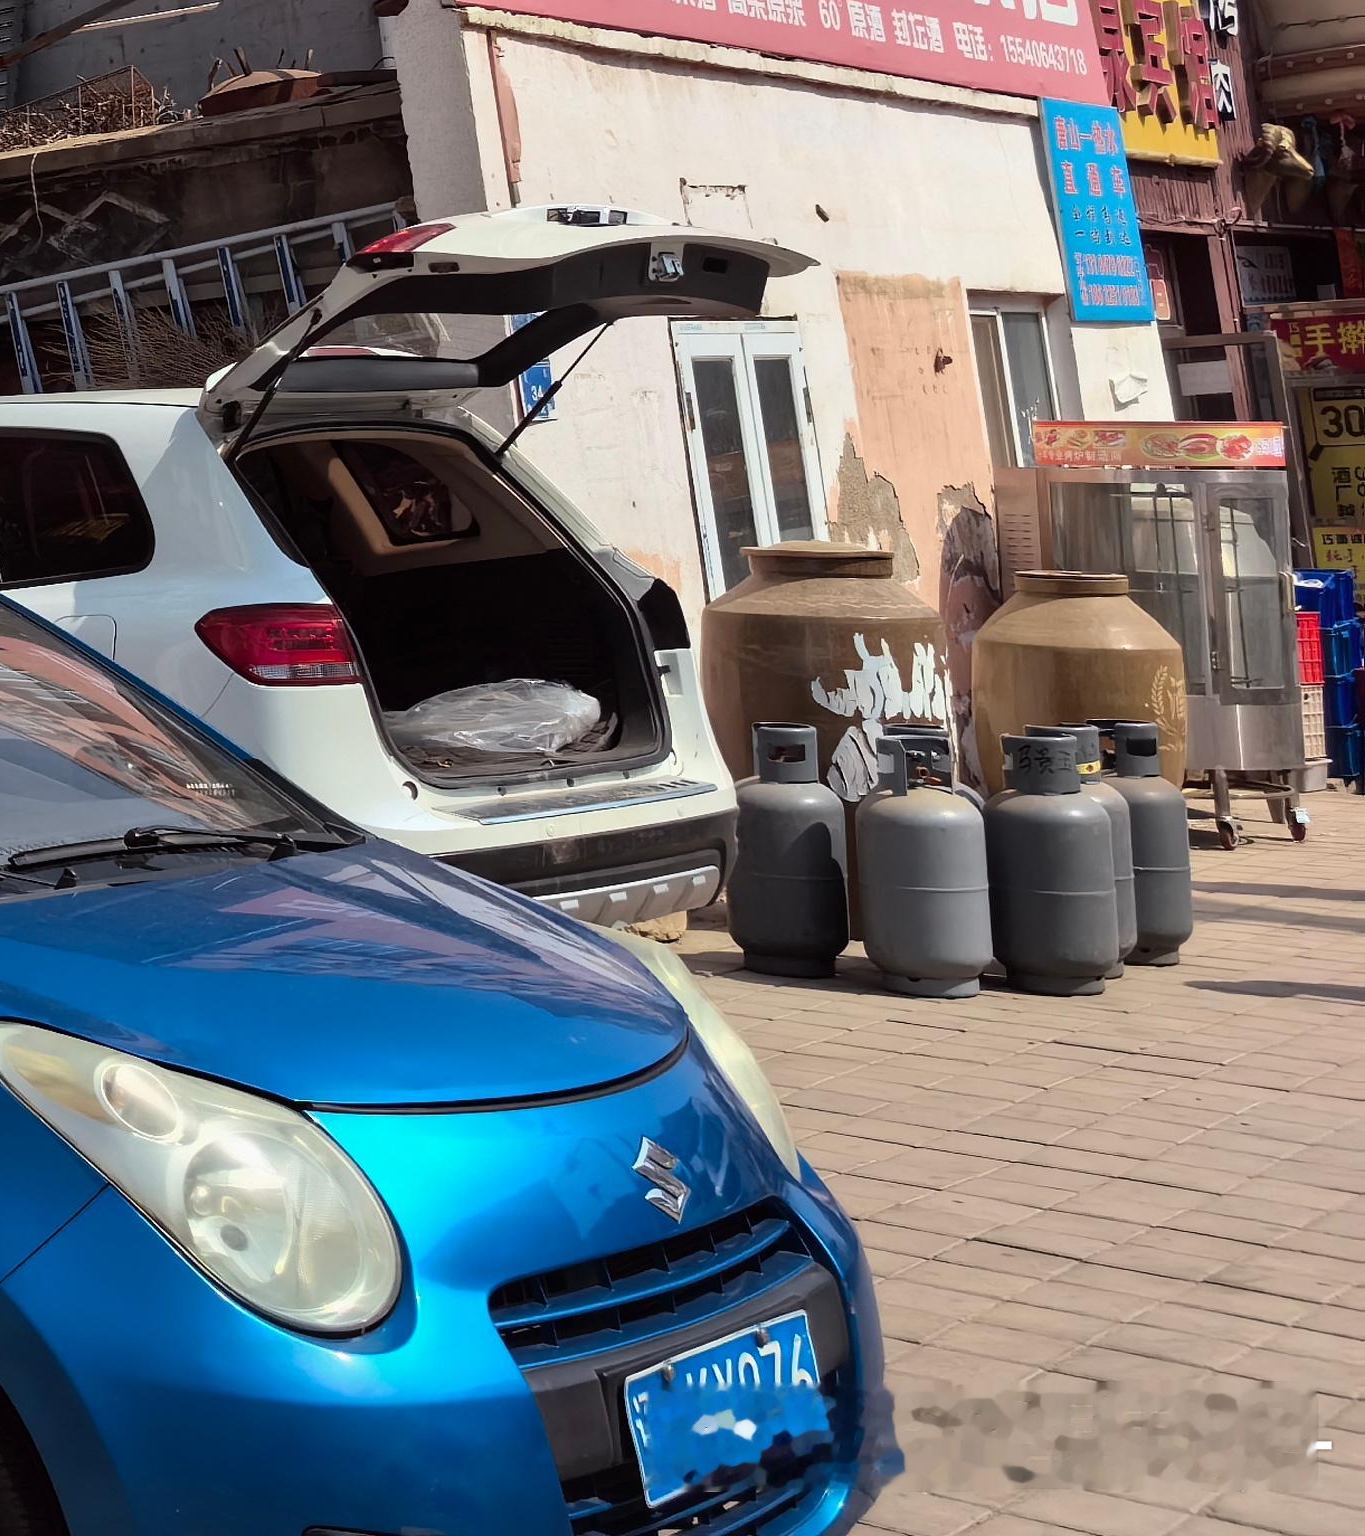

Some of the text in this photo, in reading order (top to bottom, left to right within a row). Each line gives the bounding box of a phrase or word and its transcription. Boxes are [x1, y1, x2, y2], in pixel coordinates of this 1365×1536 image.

[891, 8, 945, 54] 封坛酒
[1000, 34, 1088, 75] 15540643718
